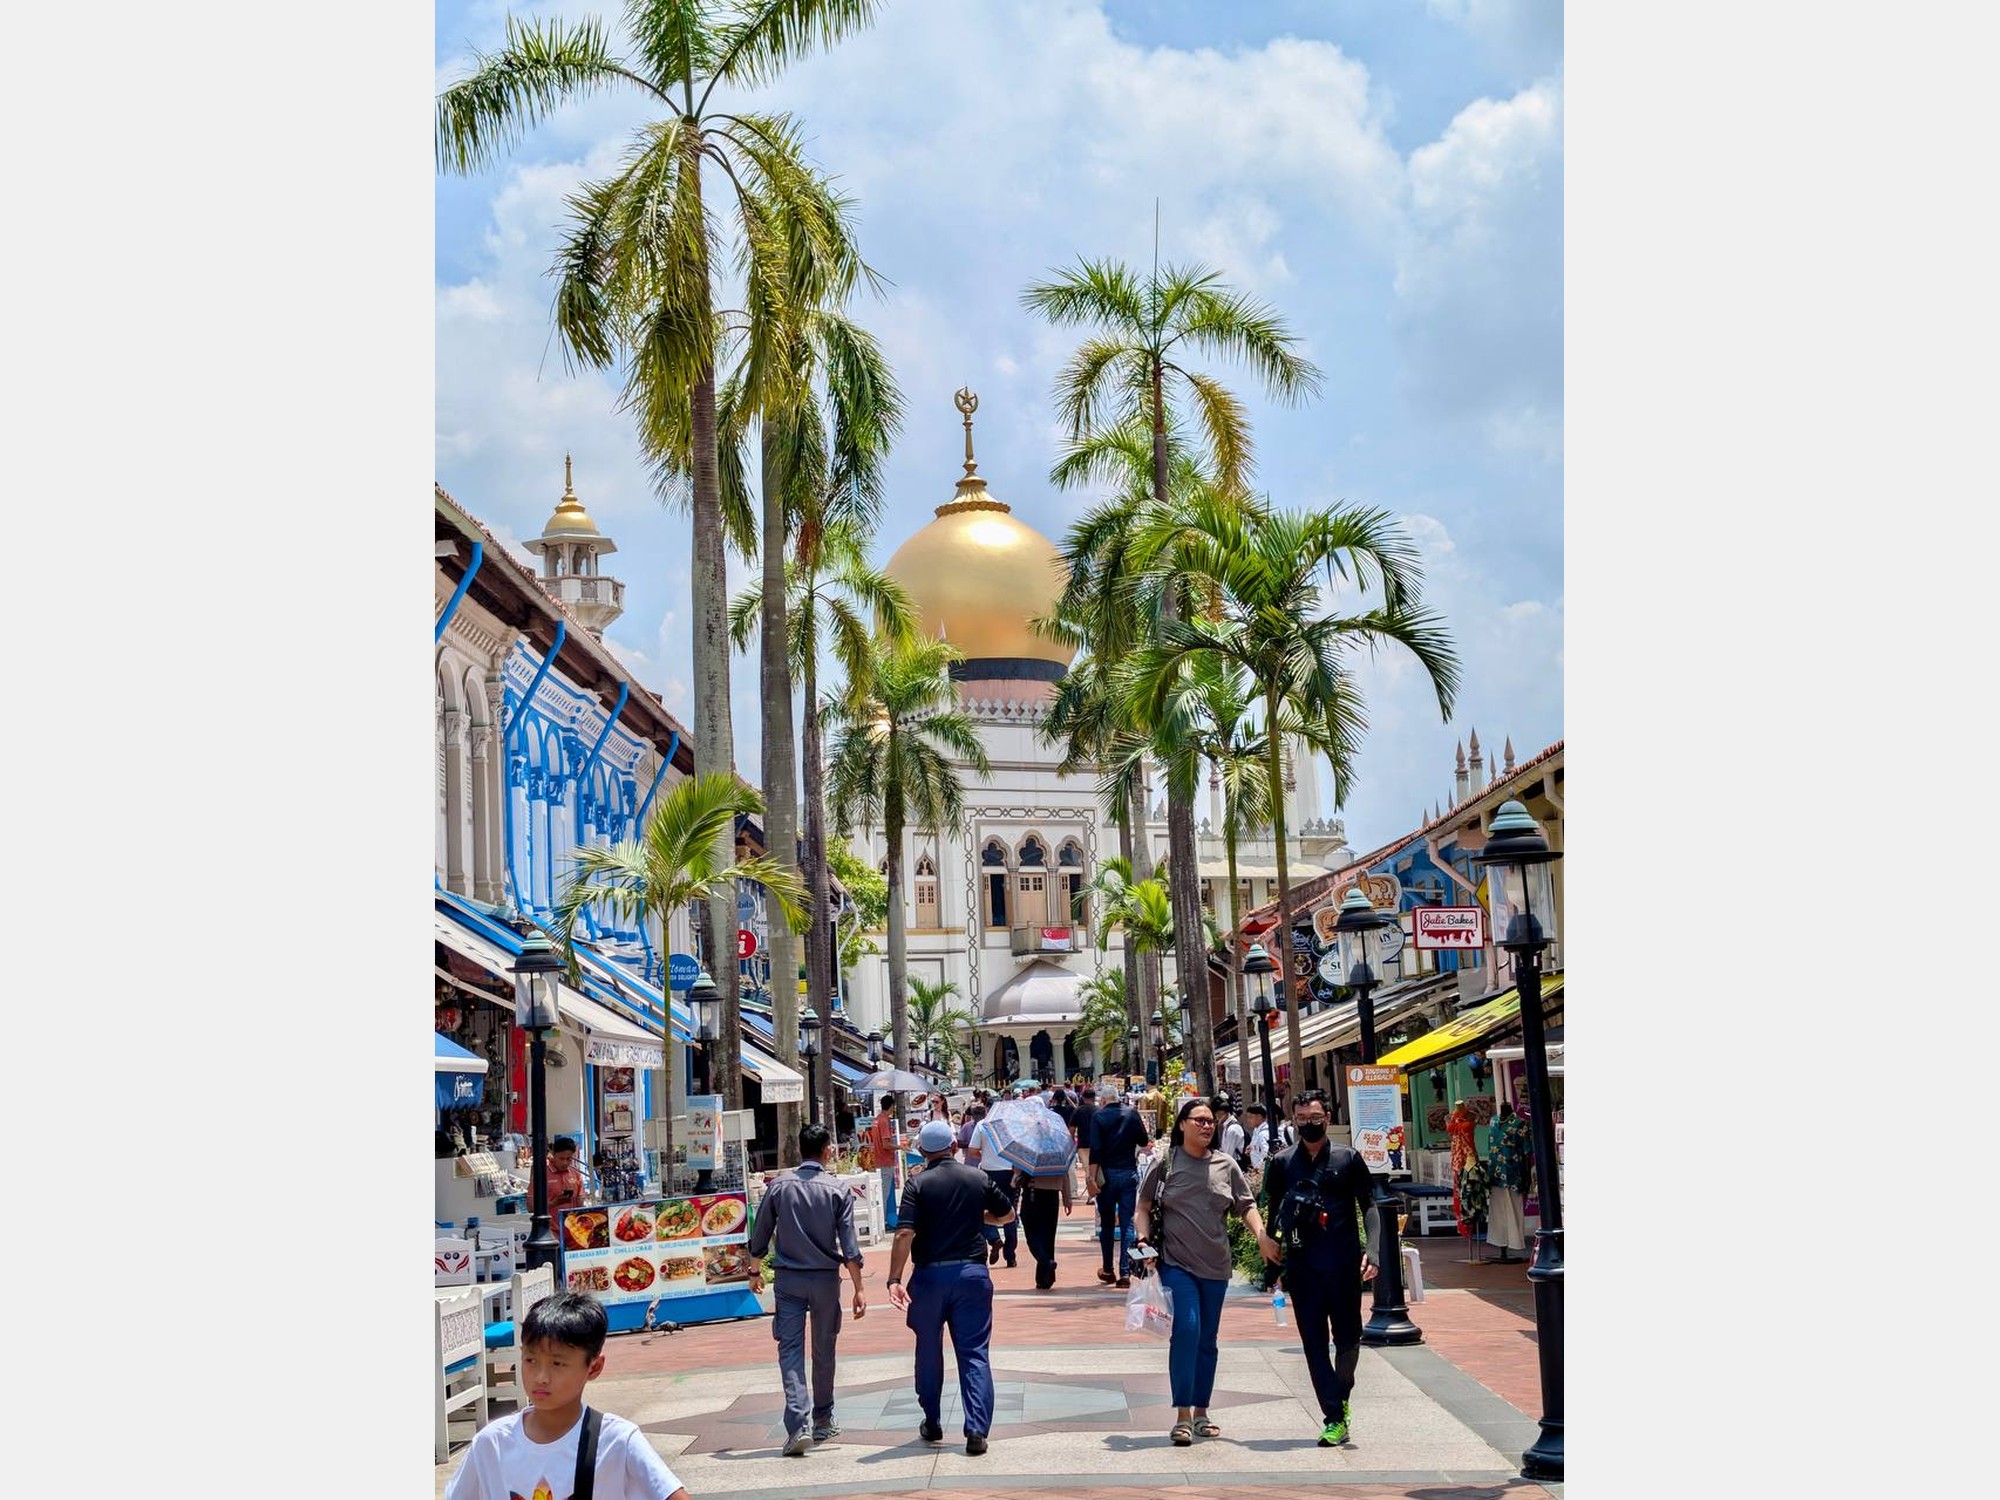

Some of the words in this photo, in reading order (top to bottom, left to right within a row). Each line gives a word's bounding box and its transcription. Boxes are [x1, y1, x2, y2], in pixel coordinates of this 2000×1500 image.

[1423, 914, 1446, 928] Julie
[1446, 914, 1474, 925] Bakes
[614, 1245, 634, 1254] CHILLI
